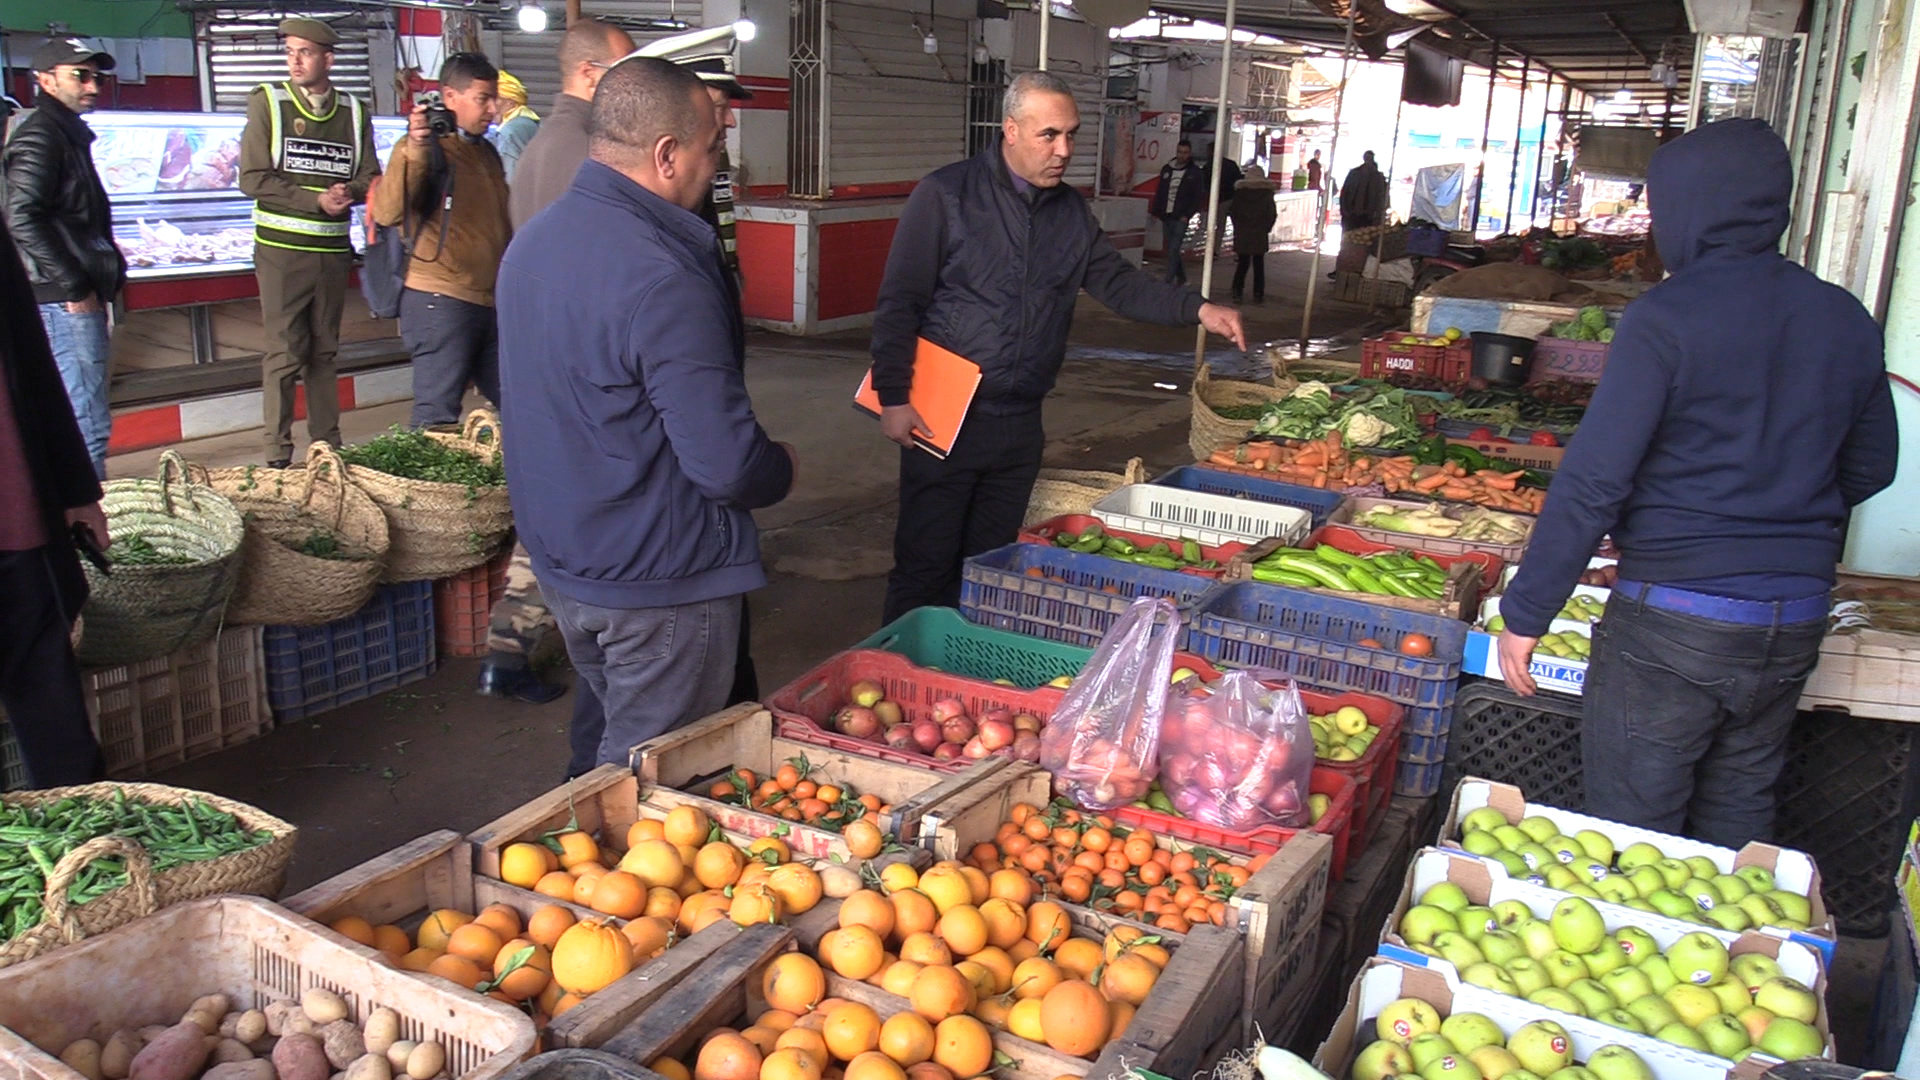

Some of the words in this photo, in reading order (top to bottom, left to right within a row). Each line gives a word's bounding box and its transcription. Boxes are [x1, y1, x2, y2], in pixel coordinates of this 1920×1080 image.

[1136, 138, 1159, 160] 10
[286, 156, 316, 170] FORCES
[1386, 357, 1414, 370] HADDI
